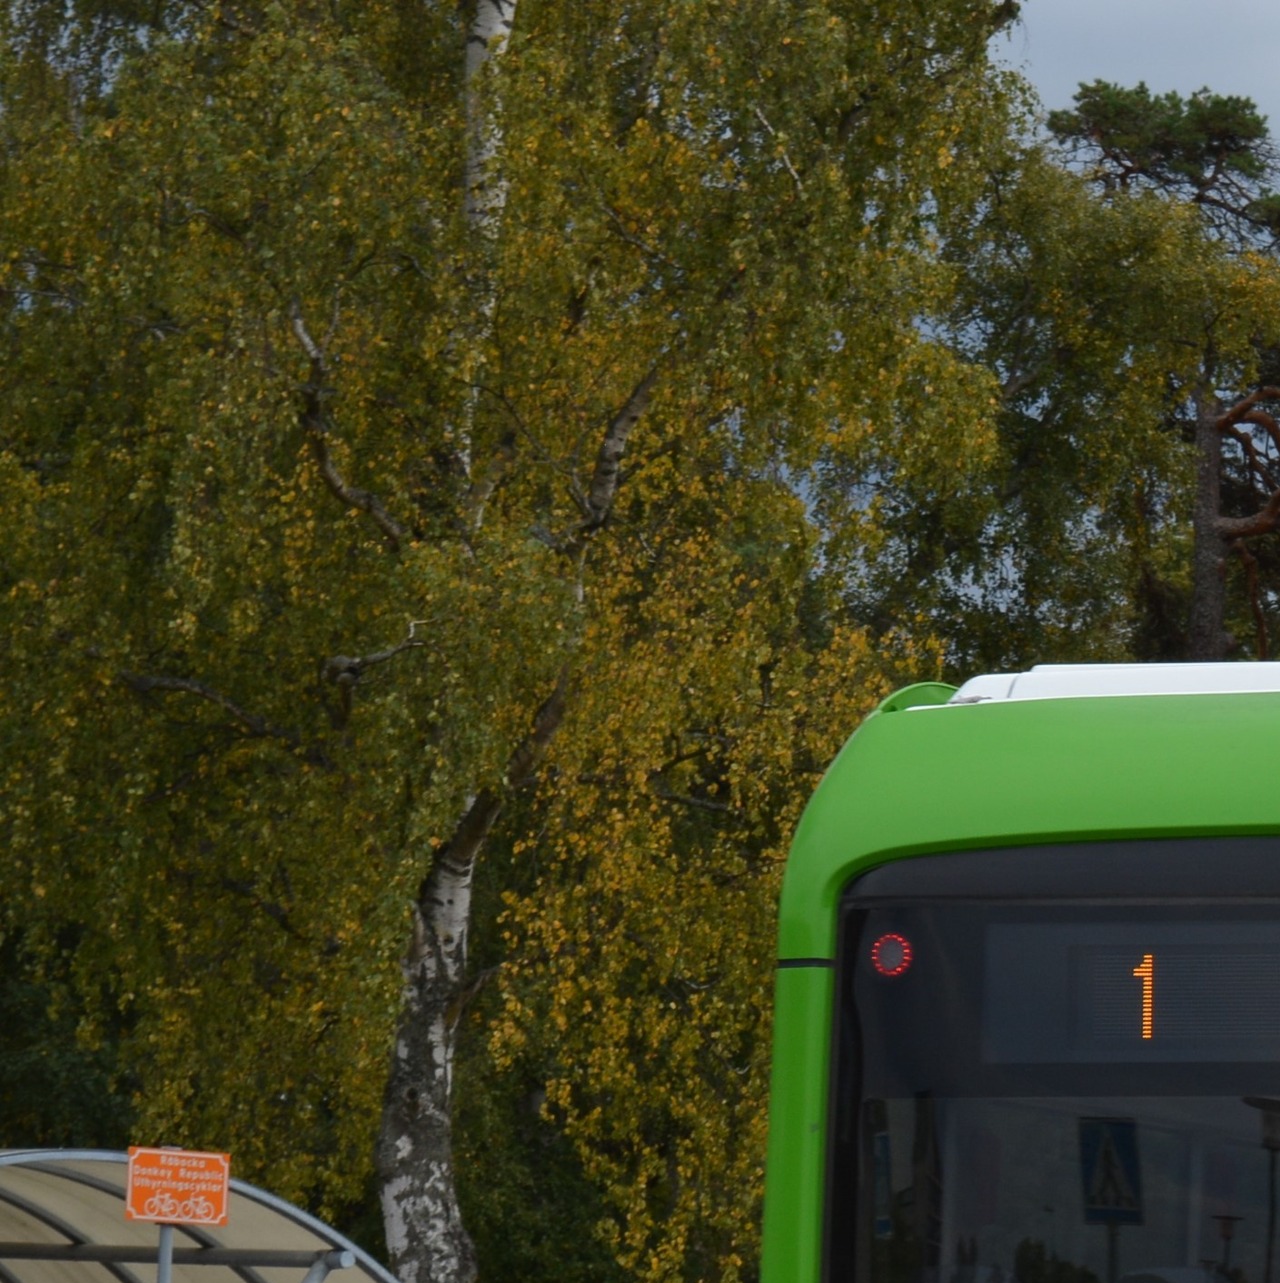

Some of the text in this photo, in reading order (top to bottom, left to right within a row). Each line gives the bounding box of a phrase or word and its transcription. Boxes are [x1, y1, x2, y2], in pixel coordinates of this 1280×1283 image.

[1133, 954, 1153, 1039] 1
[133, 1164, 224, 1181] Donkey Republic
